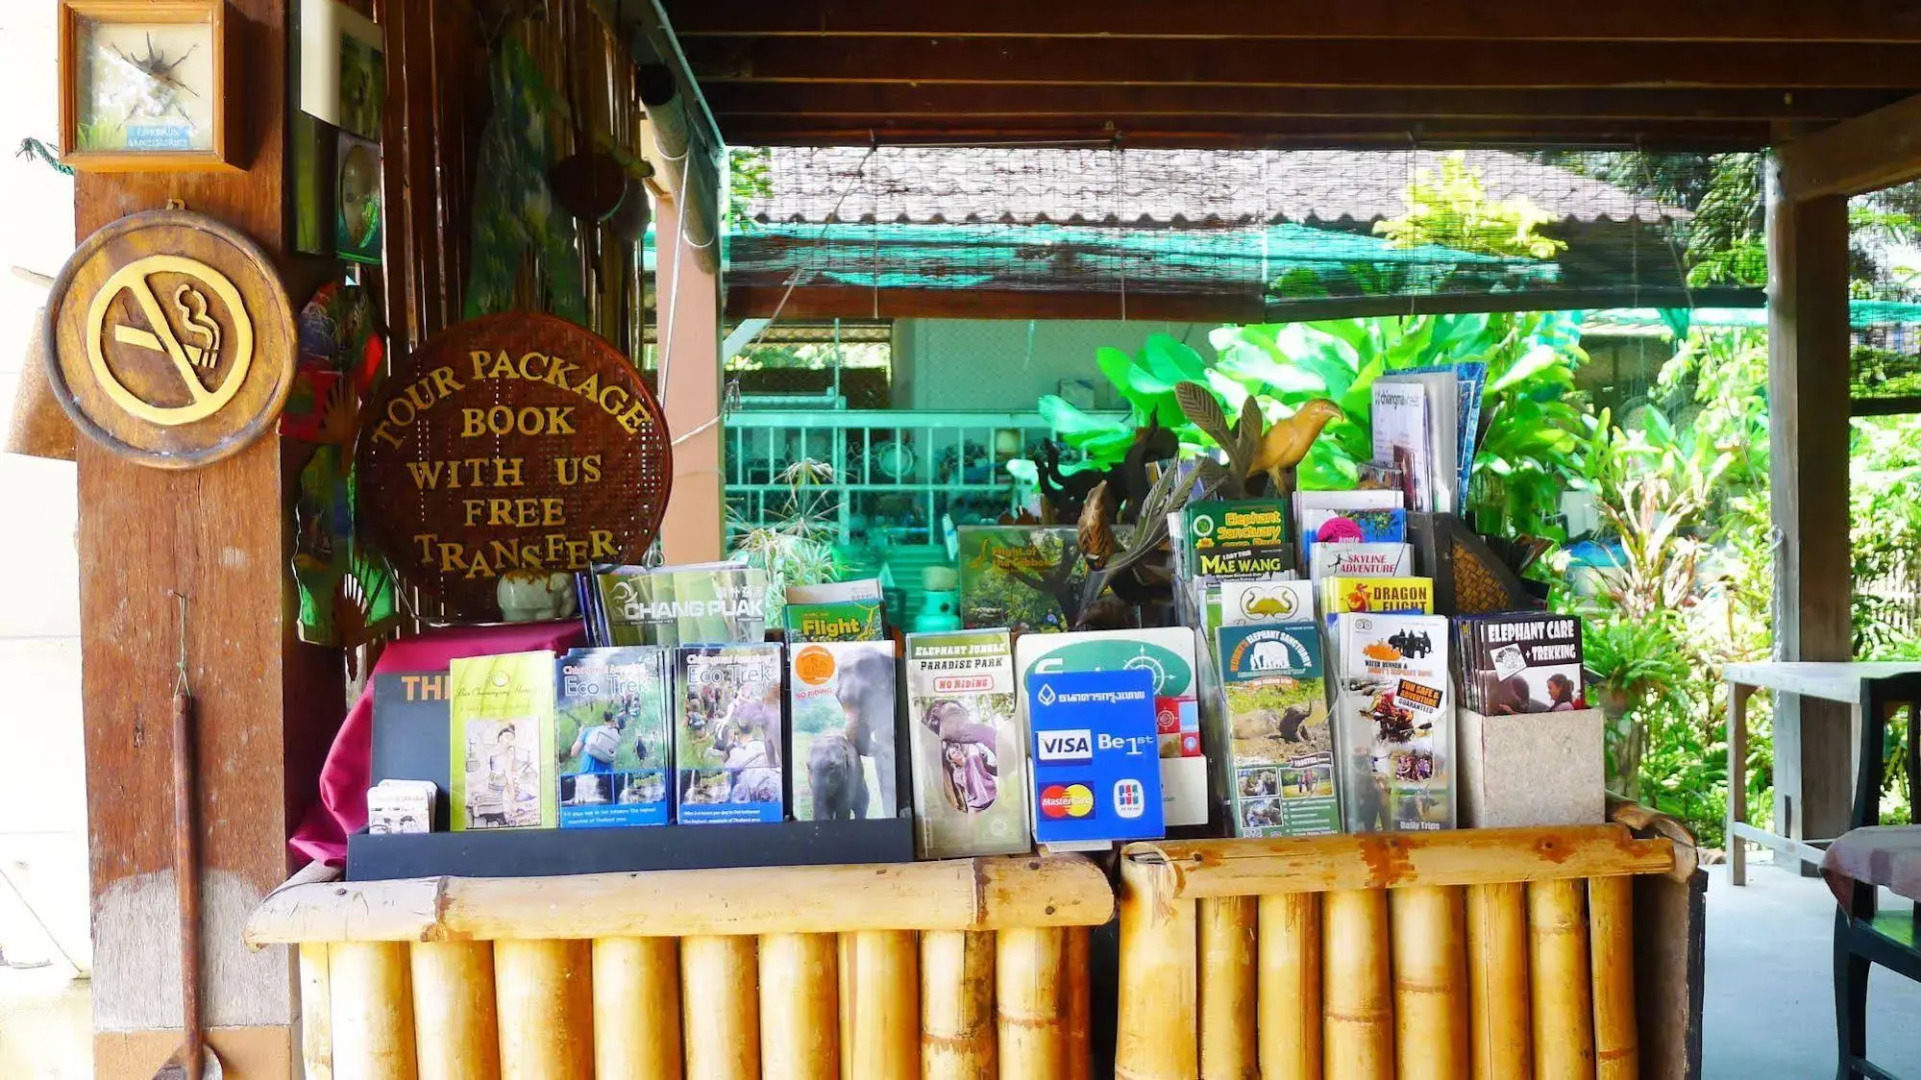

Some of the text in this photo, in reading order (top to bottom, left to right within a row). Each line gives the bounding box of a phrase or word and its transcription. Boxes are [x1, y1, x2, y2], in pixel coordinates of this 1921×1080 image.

[371, 350, 652, 450] TOUR PACKAGE
[461, 406, 576, 437] BOOK
[407, 454, 602, 490] WITH US
[463, 498, 567, 527] FREE
[1225, 511, 1281, 526] Elephant
[1217, 526, 1281, 541] Sanctuary
[413, 529, 619, 579] TRANSFER
[1348, 554, 1387, 563] SKYLINE
[1200, 554, 1281, 575] MAE WANG
[1341, 564, 1395, 573] ADVENTURE
[1374, 586, 1427, 600] DRAGON
[624, 598, 764, 621] CHANG PUAK
[803, 618, 860, 638] Flight
[1488, 619, 1575, 643] ELEPHANT CARE
[1245, 629, 1280, 645] ELEPHANT
[915, 645, 967, 656] ELEPHANT
[1531, 644, 1576, 661] TREKKING
[974, 658, 1003, 668] PARK
[687, 662, 771, 684] Eco Trek
[401, 675, 450, 701] TH
[564, 674, 649, 697] Eco Trek
[939, 679, 952, 689] NO
[1416, 684, 1434, 698] SAFE
[1043, 737, 1089, 753] VISA
[1400, 819, 1440, 830] Daily Trips
